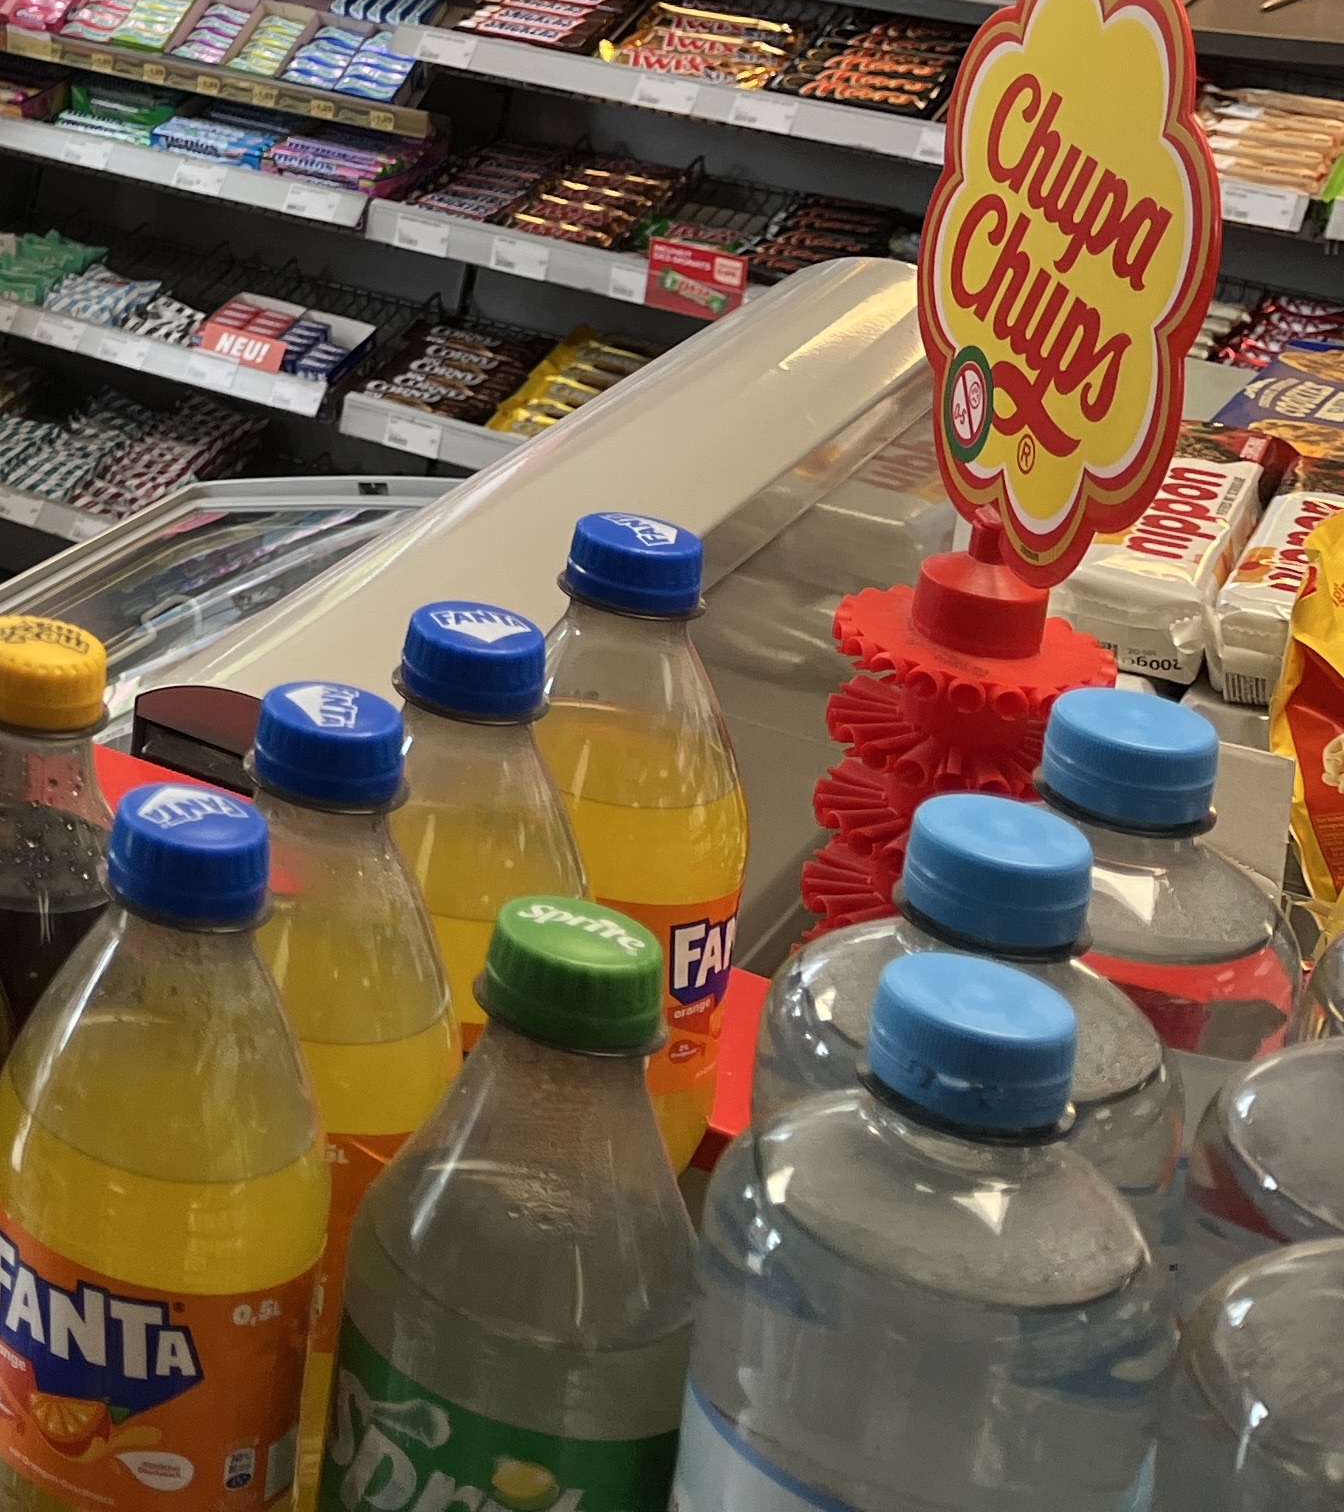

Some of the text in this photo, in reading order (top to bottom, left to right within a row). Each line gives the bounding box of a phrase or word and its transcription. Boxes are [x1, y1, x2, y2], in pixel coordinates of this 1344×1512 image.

[987, 74, 1172, 292] Chupa
[215, 333, 270, 365] NEU!
[950, 193, 1132, 457] Chups
[1125, 466, 1227, 560] nippon
[438, 610, 526, 631] FANTA
[517, 904, 646, 957] Sprite
[673, 999, 712, 1020] orange
